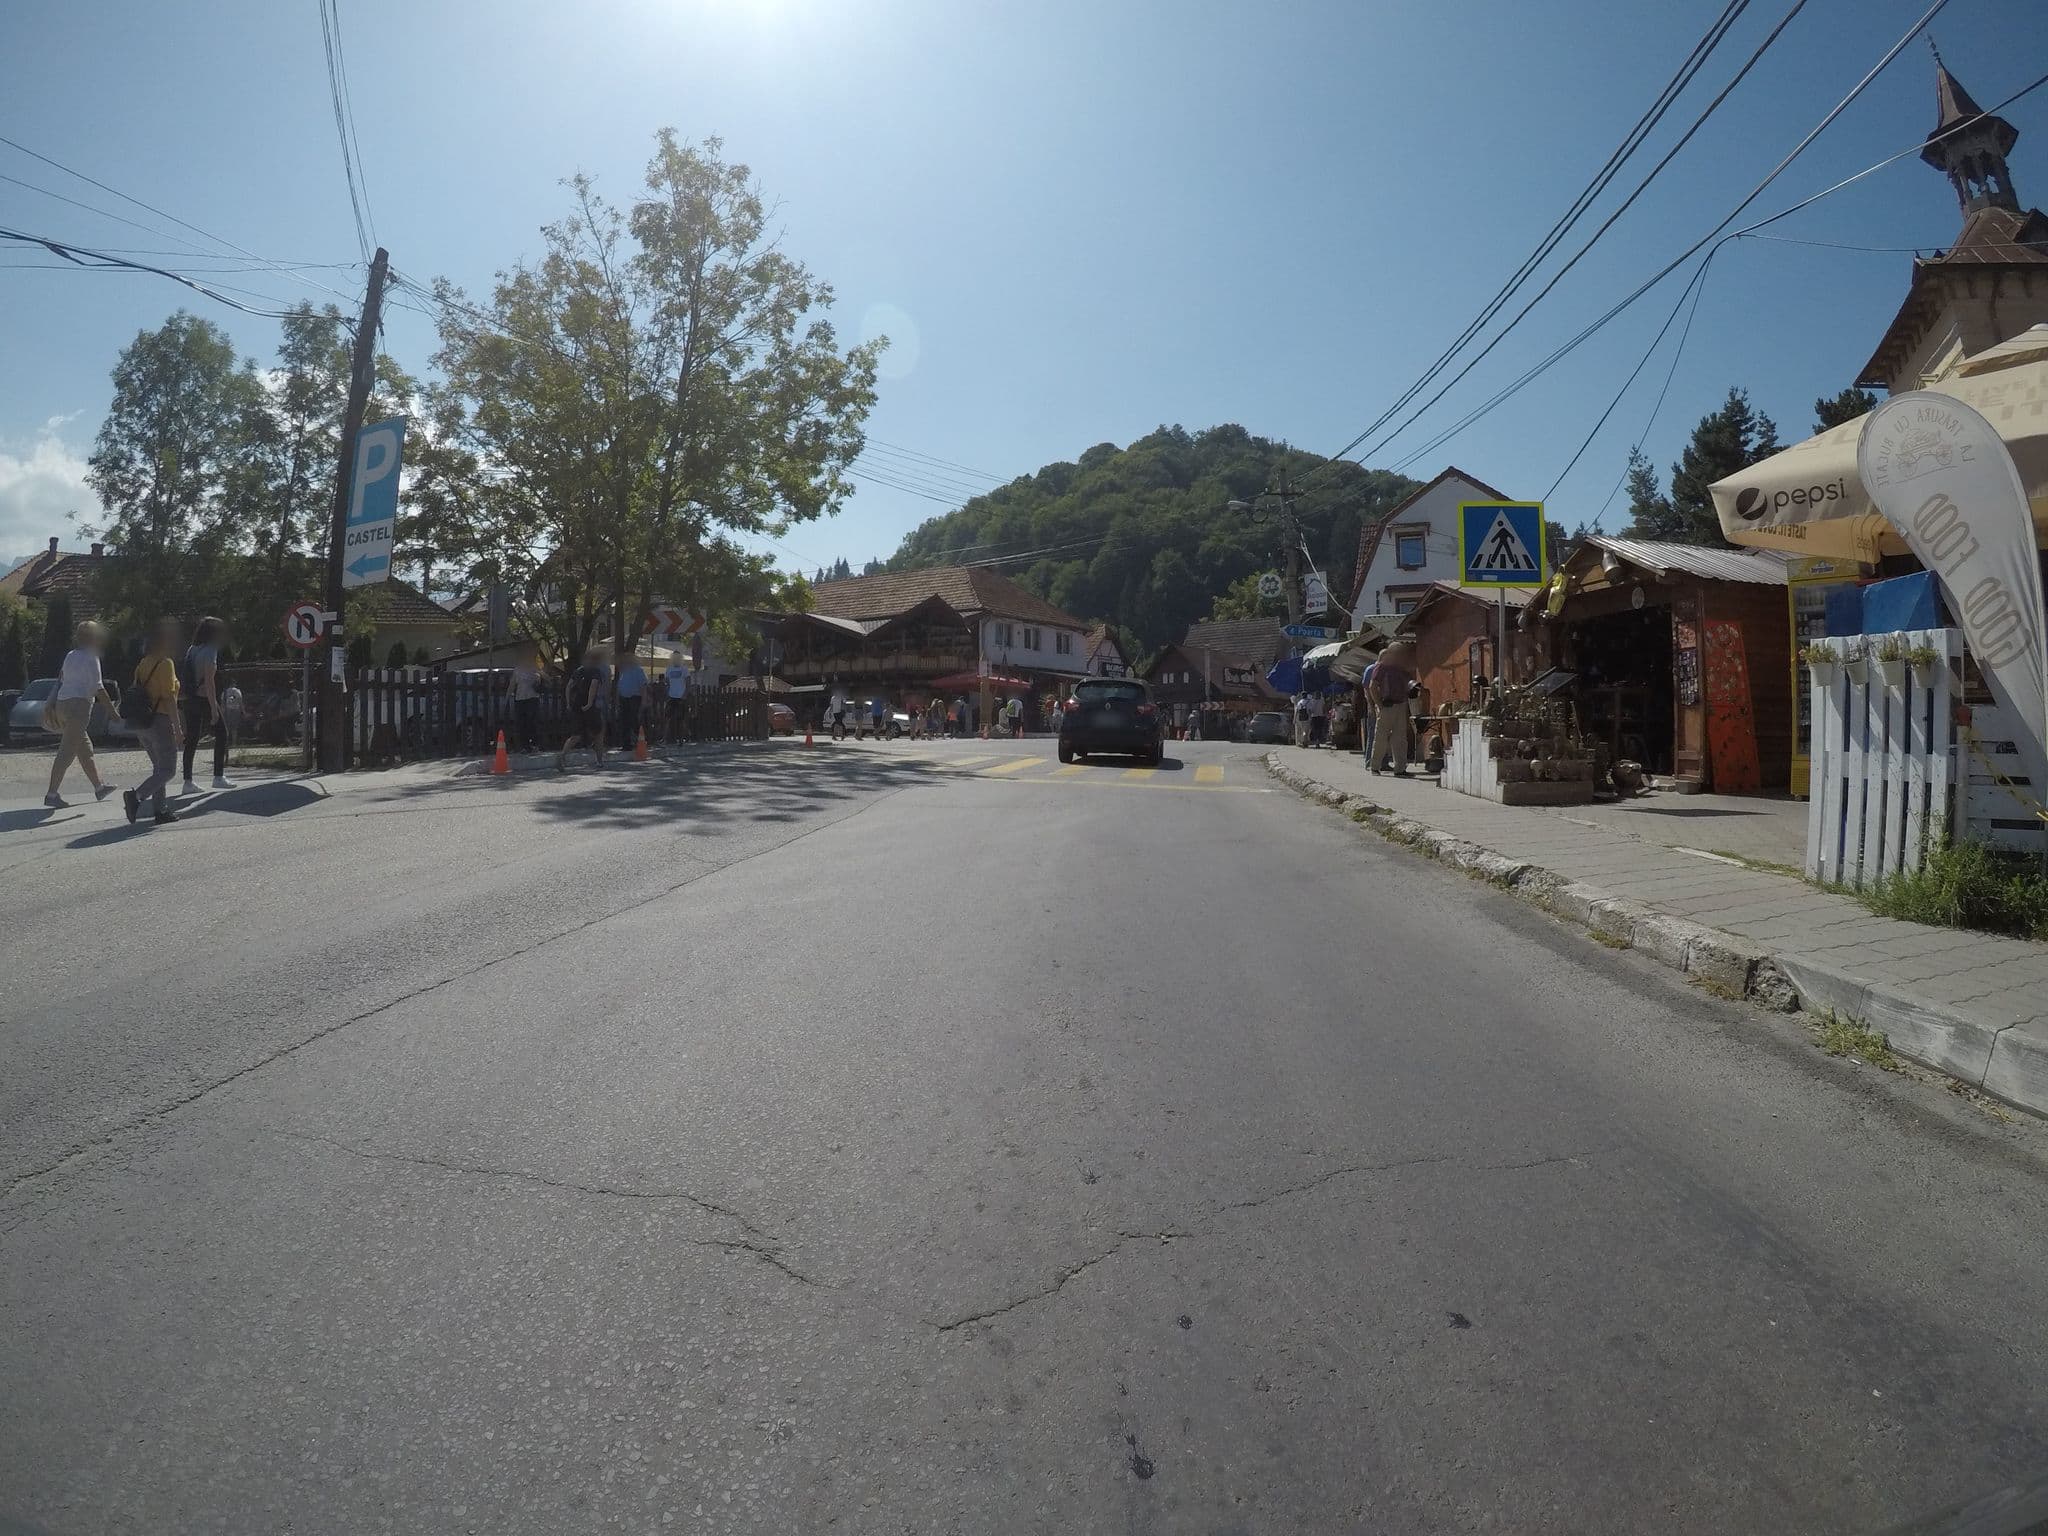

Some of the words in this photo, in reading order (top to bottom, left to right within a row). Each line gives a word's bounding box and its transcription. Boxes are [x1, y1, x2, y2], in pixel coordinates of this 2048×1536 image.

[352, 429, 397, 518] P
[1774, 478, 1846, 512] pepsi
[347, 526, 391, 546] CASTEL
